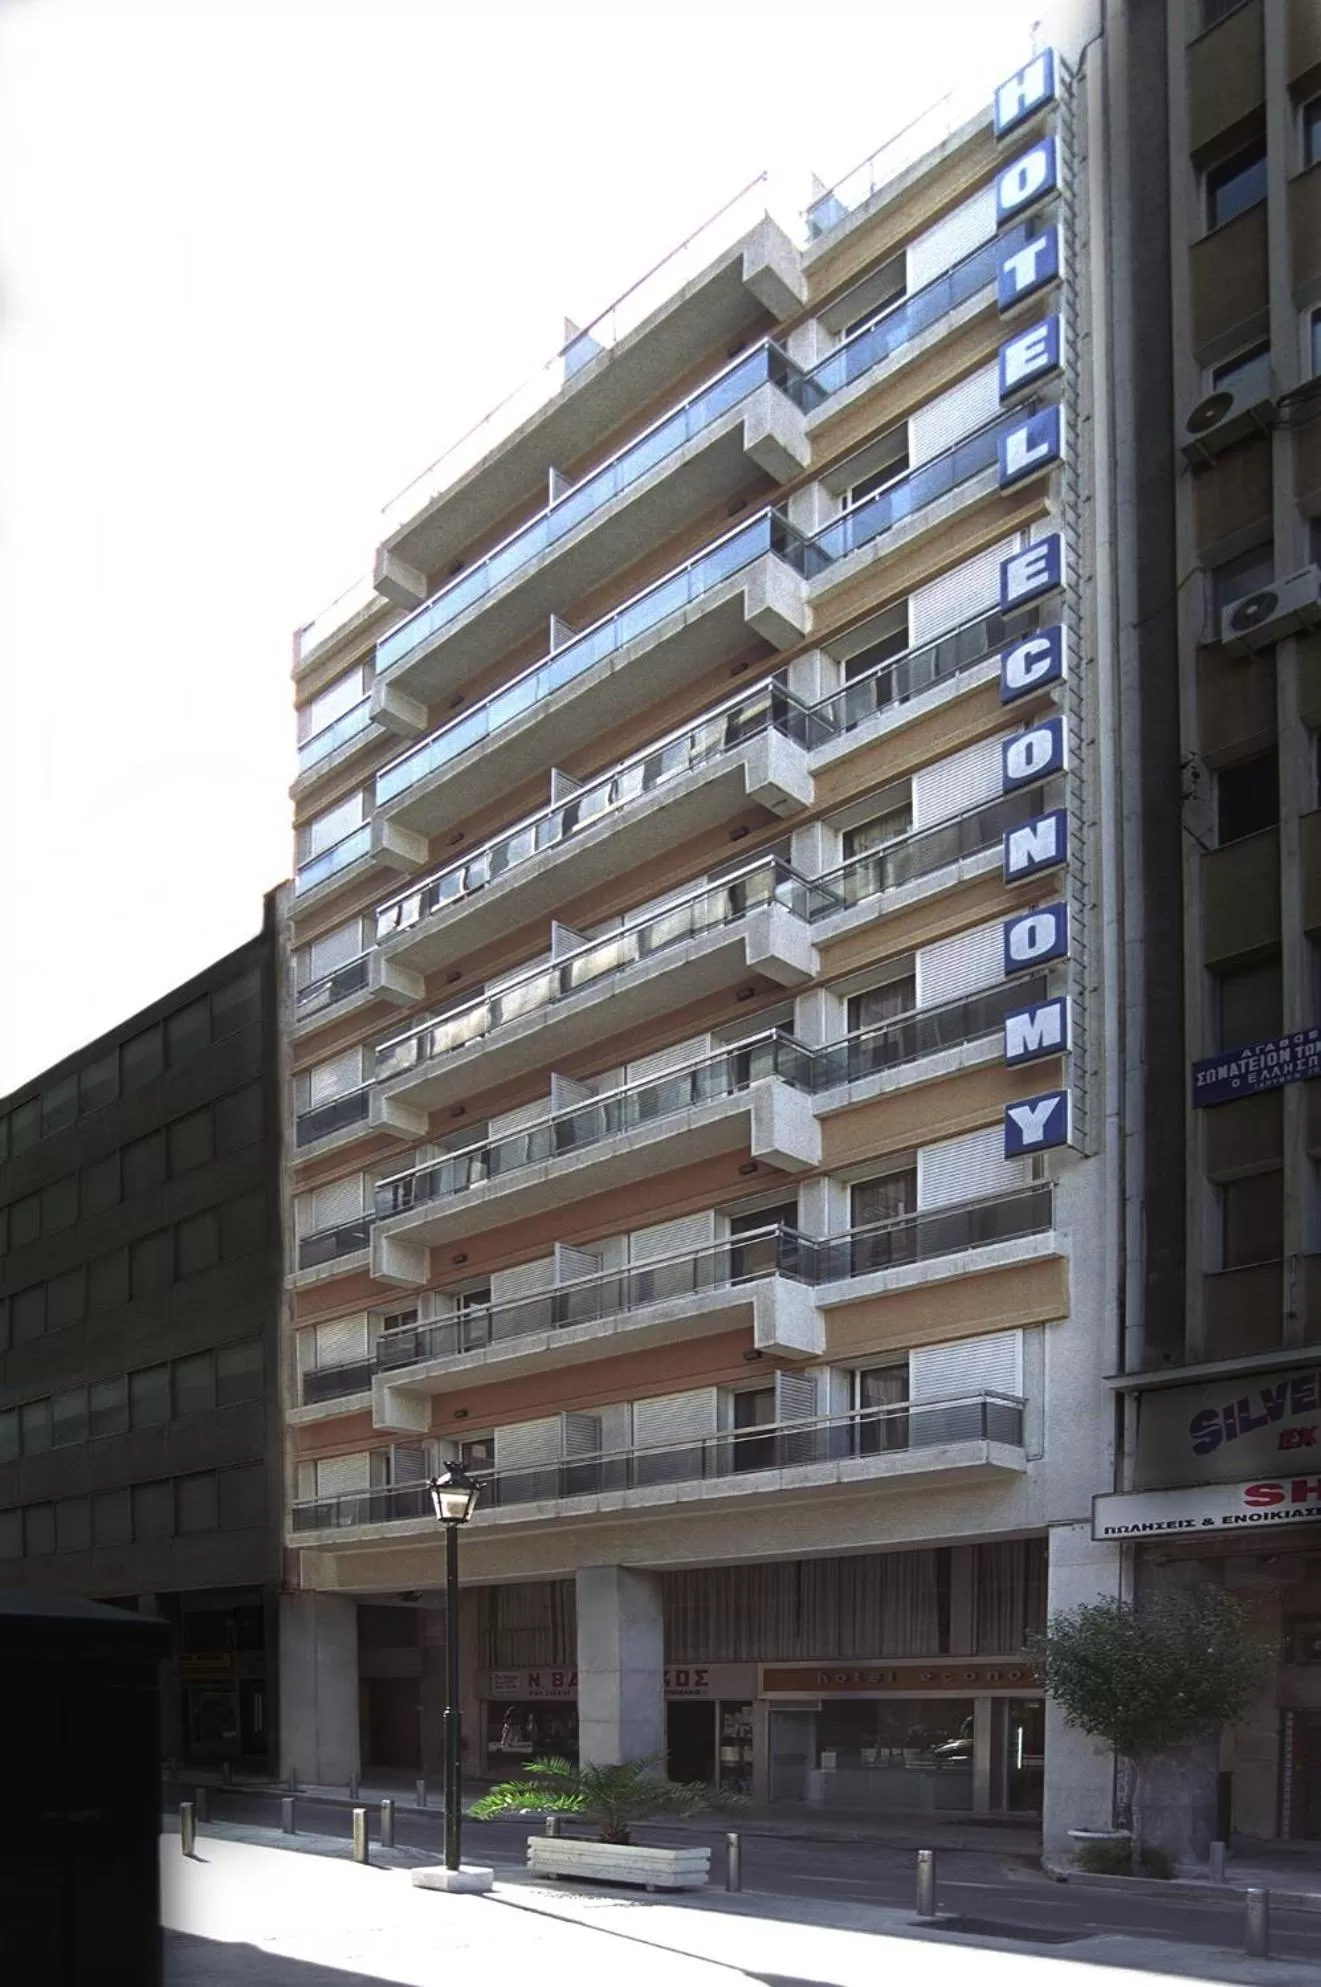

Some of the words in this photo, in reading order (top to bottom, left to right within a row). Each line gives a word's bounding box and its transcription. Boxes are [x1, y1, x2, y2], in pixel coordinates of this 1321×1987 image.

[1000, 60, 1049, 477] HOTEL
[1005, 543, 1060, 1145] ECONOMY
[1190, 1371, 1321, 1456] SILVE
[1104, 1518, 1196, 1535] ΠΩΛΗΣΕΙΣ
[1202, 1517, 1215, 1526] &
[920, 1669, 1024, 1683] econo
